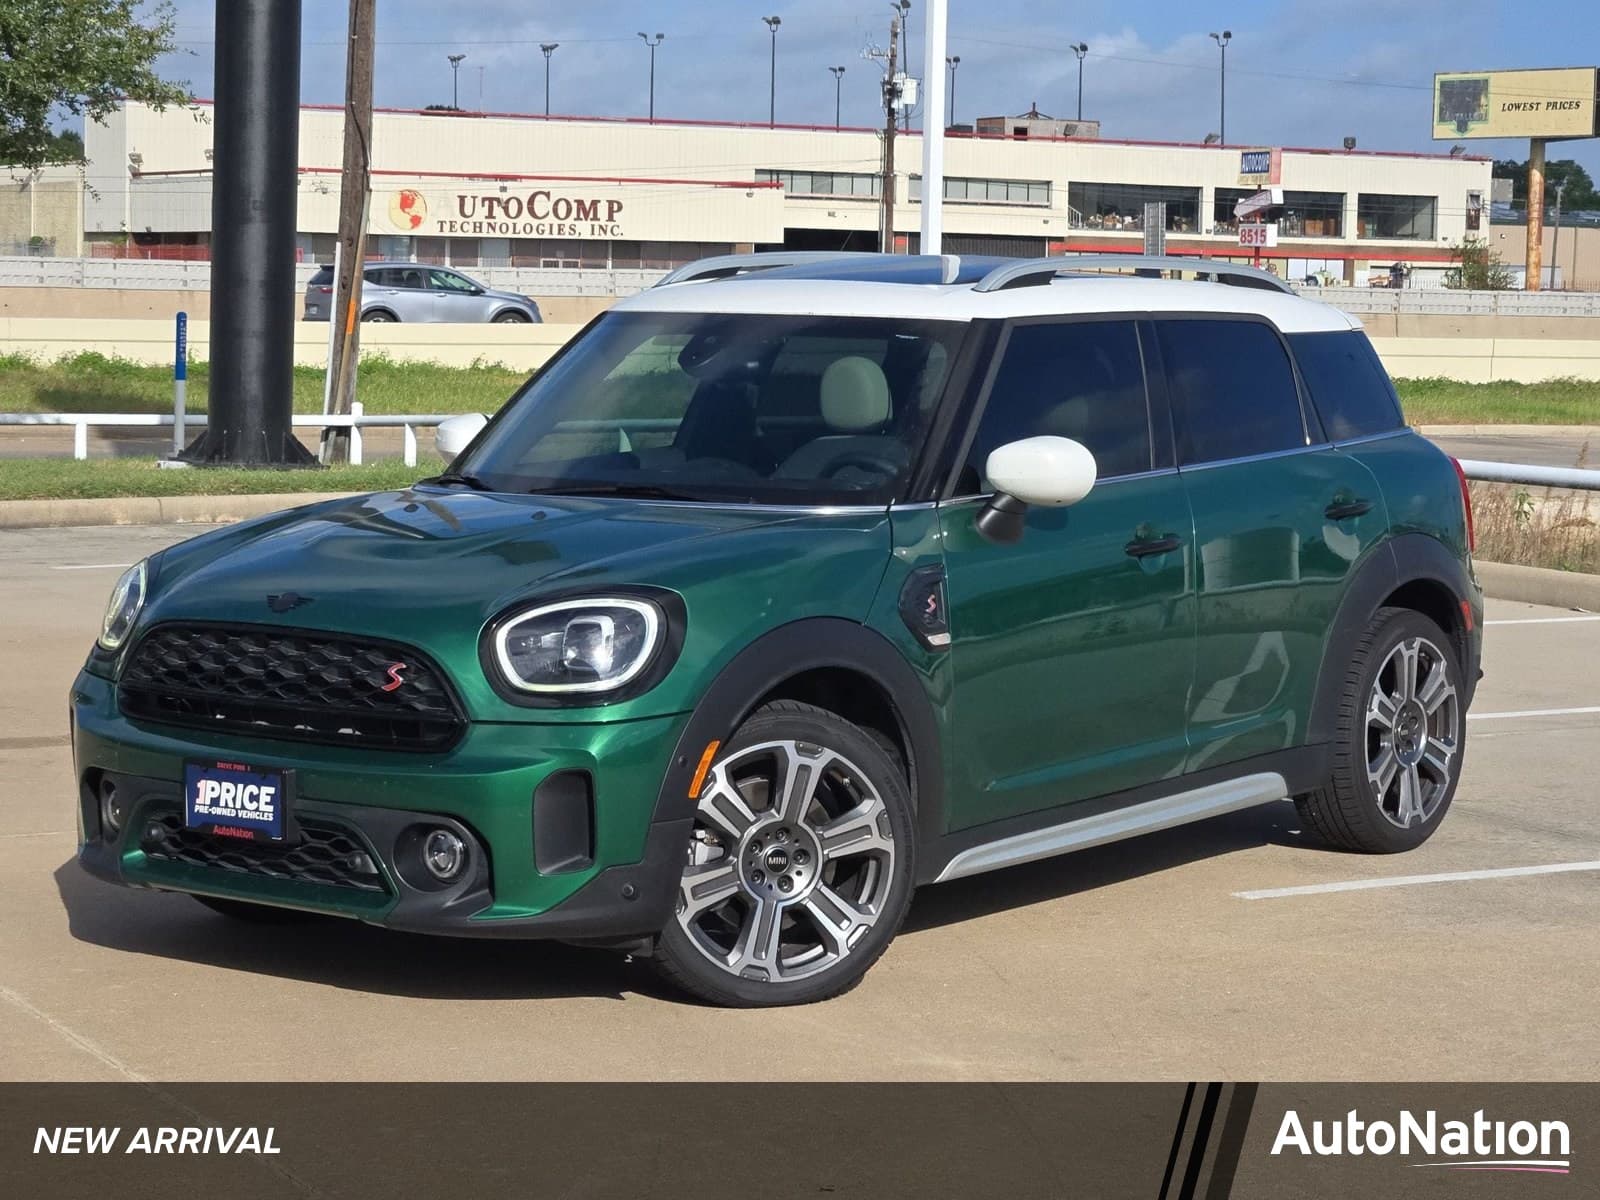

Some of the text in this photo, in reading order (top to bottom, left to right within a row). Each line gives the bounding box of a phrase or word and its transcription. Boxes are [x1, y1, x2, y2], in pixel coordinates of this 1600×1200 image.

[1501, 100, 1581, 112] LOWEST PRICES
[437, 220, 624, 237] TECHNOLOGIES, INC.
[1240, 229, 1266, 244] 8515
[381, 662, 408, 692] S
[194, 804, 274, 821] PRE-OWNED VEHICLES
[212, 825, 254, 840] AutoNation
[768, 856, 787, 865] MINI
